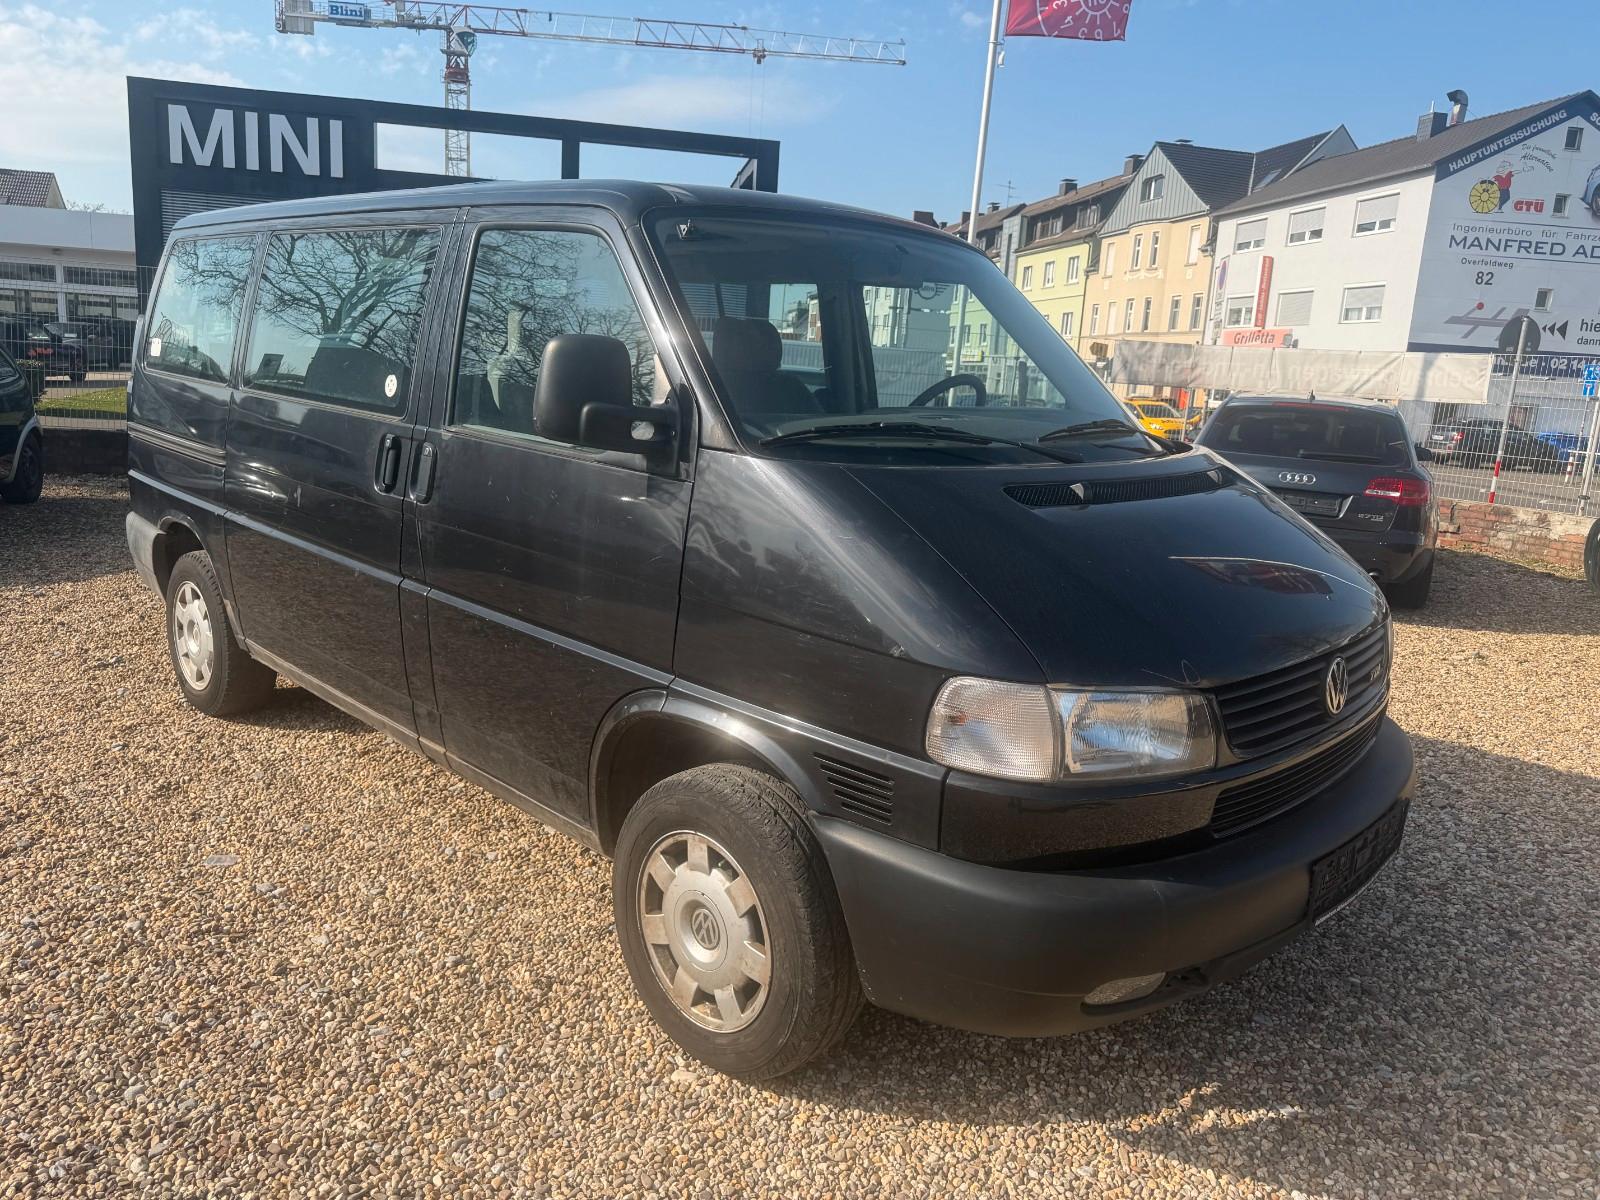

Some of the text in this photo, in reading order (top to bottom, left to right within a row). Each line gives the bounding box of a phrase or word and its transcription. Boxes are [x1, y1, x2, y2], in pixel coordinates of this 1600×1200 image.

[329, 5, 363, 18] Blini
[168, 104, 343, 178] MINI
[1448, 110, 1568, 172] HAUPTUNTERSUCHUNG
[1513, 199, 1545, 214] GTÜ
[1452, 223, 1533, 237] Ingenieurbüro
[1541, 229, 1557, 239] für
[1449, 234, 1566, 257] MANFRED
[1475, 271, 1495, 286] 82
[1233, 332, 1276, 345] Grilletta
